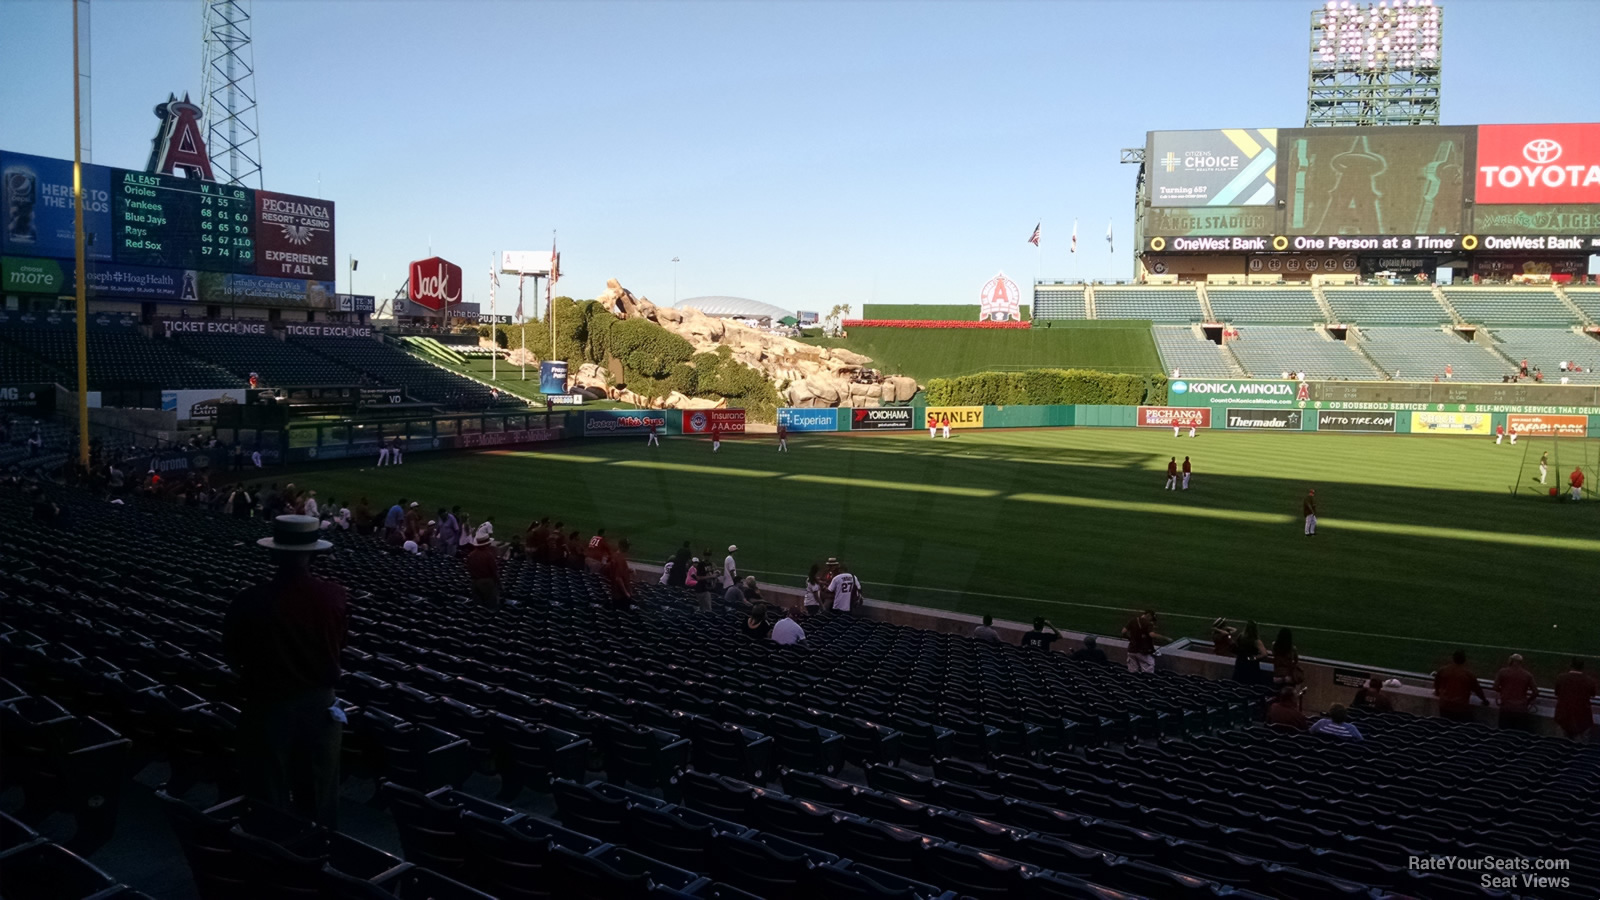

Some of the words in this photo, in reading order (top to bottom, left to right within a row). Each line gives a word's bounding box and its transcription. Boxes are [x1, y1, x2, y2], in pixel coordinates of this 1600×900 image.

[1185, 156, 1239, 167] CHOICE
[124, 173, 136, 183] AL
[138, 174, 161, 185] EAST
[1480, 165, 1600, 188] TOYOTA
[42, 183, 87, 199] HERES
[91, 189, 108, 201] TO
[124, 185, 156, 197] Orioles
[201, 196, 211, 205] 74
[218, 198, 228, 207] 55
[201, 184, 209, 193] W
[233, 190, 245, 199] GB
[1160, 186, 1193, 194] Turning
[42, 195, 66, 208] THE
[125, 198, 162, 211] Yankees
[201, 208, 212, 217] 68
[218, 211, 228, 219] 61
[235, 213, 248, 222] 6.0
[262, 198, 330, 218] PECHANGA
[125, 212, 145, 223] Blue
[146, 214, 167, 225] Jays
[201, 221, 212, 230] 66
[218, 224, 229, 232] 65
[235, 225, 248, 234] 9.0
[262, 212, 294, 224] RESORT
[301, 217, 330, 229] CASINO
[1160, 214, 1203, 230] ANGEL
[1205, 215, 1265, 229] STADIUM
[125, 225, 147, 237] Rays
[201, 234, 213, 243] 64
[218, 236, 229, 245] 67
[233, 238, 251, 246] 11.0
[125, 239, 143, 249] Red
[145, 241, 162, 250] Sox
[201, 246, 213, 255] 57
[218, 248, 229, 256] 74
[1174, 237, 1230, 250] OneWest
[1232, 236, 1265, 250] Bank
[1294, 236, 1324, 249] One
[1328, 236, 1379, 249] Person
[1382, 236, 1399, 249] at
[1402, 239, 1412, 249] a
[1415, 236, 1453, 249] Time
[1485, 236, 1545, 249] OneWest
[1547, 236, 1582, 249] Bank
[265, 250, 329, 266] EXPERIENCE
[20, 265, 43, 273] choose
[282, 264, 293, 274] IT
[294, 264, 313, 275] ALL
[10, 271, 54, 285] more
[87, 271, 113, 284] oseph
[123, 272, 145, 285] Hoag
[146, 274, 173, 285] Health
[414, 263, 461, 302] Jack
[453, 309, 465, 317] the
[162, 321, 205, 332] TICKET
[286, 325, 320, 336] TICKET
[1189, 383, 1237, 394] KONICA
[1239, 384, 1293, 395] MINOLTA
[1210, 397, 1293, 405] CountOnKonicaMinolta.com
[1343, 402, 1389, 410] HOUSEHOLD
[1390, 403, 1427, 411] SERVICES
[868, 410, 909, 419] YOKOHAMA
[1146, 409, 1203, 419] PECHANGA
[1475, 405, 1522, 413] SELF-MOVING
[1524, 406, 1556, 414] SERVICES
[711, 412, 745, 420] Insuranc
[794, 414, 833, 426] Experian
[927, 411, 982, 424] STANLEY
[1229, 416, 1288, 428] Thermador
[1350, 418, 1393, 426] TIRE.COM
[1511, 423, 1552, 433] SAFARI
[841, 582, 853, 593] 27
